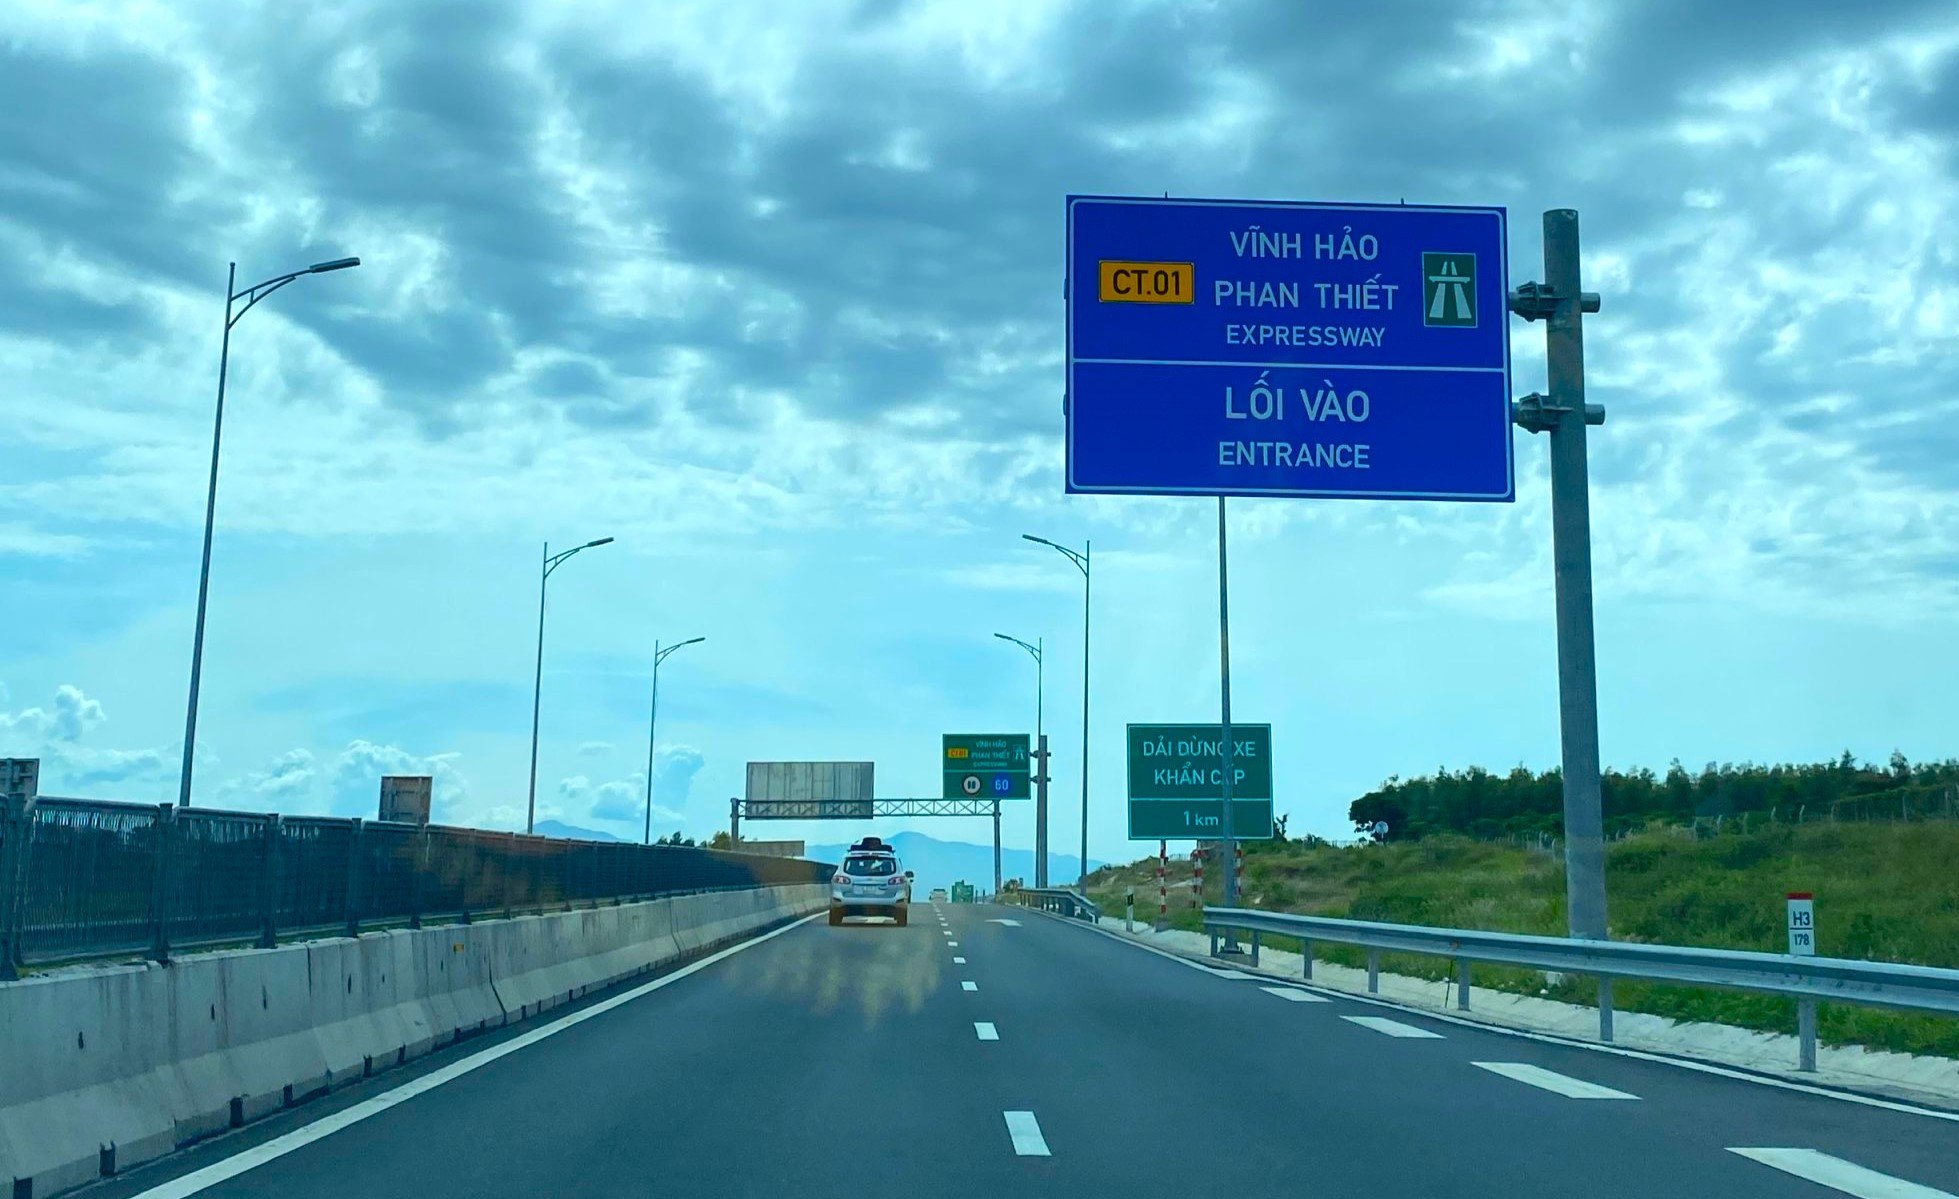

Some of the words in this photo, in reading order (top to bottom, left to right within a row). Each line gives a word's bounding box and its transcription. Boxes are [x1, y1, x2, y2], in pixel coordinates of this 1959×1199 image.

[1230, 225, 1301, 259] VĨNH
[1315, 226, 1378, 260] HẢO
[1112, 269, 1181, 296] CT.01
[1215, 280, 1299, 308] PHAN
[1314, 273, 1399, 310] THIẾT
[1227, 324, 1385, 347] EXPRESSWAY
[1225, 370, 1284, 421] LỐI
[1300, 379, 1370, 423] VÀO
[1218, 441, 1371, 469] ENTRANCE
[1143, 735, 1172, 757] DẢI
[1233, 741, 1256, 757] XE
[995, 779, 1009, 791] 60
[1154, 761, 1205, 786] KHẨN
[1211, 763, 1245, 785] CP
[1183, 810, 1190, 826] 1
[1195, 811, 1219, 826] km
[1792, 911, 1811, 926] H3
[1794, 933, 1809, 945] 178
